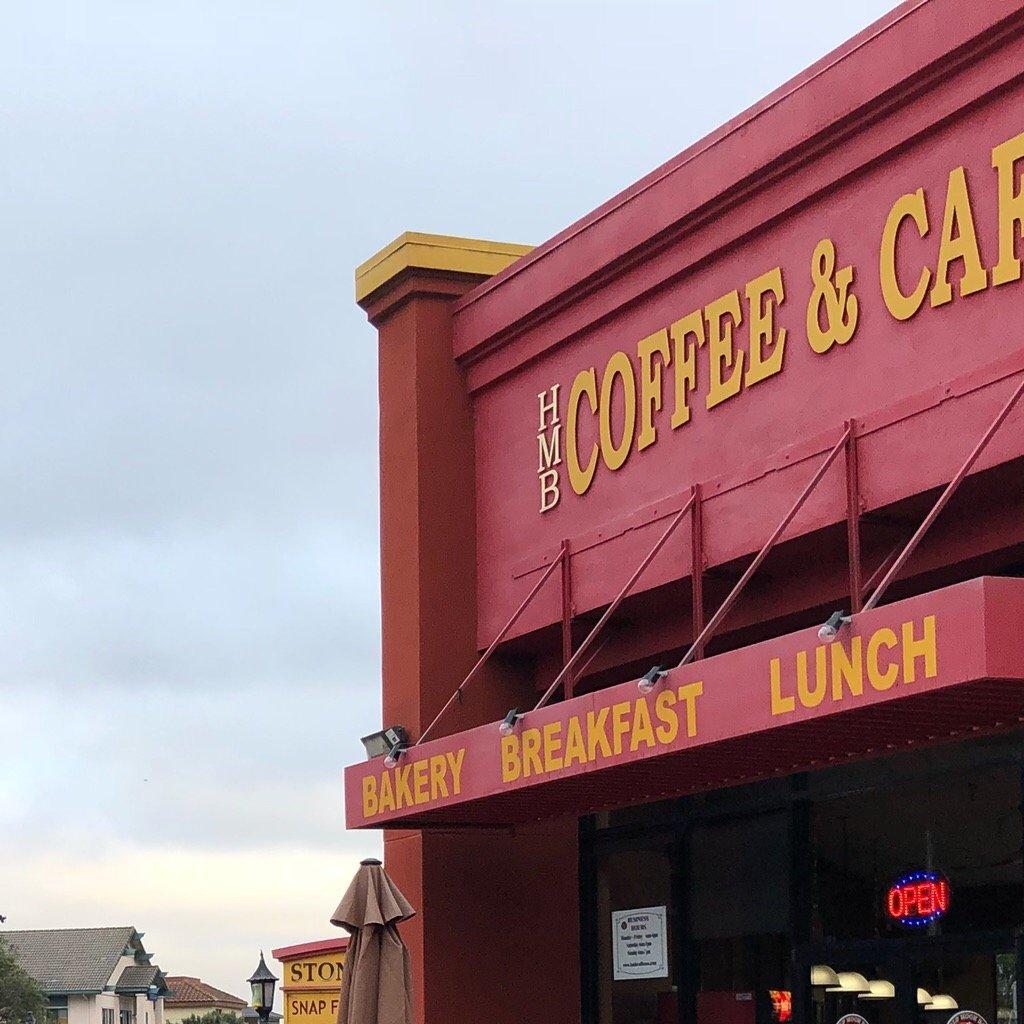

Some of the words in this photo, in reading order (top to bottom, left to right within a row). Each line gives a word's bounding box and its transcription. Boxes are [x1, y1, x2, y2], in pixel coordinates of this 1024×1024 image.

[566, 266, 787, 495] COFFEE
[807, 238, 859, 354] &
[362, 748, 466, 818] BAKERY
[501, 680, 704, 784] BREAKFAST
[769, 614, 938, 716] LUNCH
[888, 881, 946, 917] OPEN
[291, 1000, 326, 1016] SNAP
